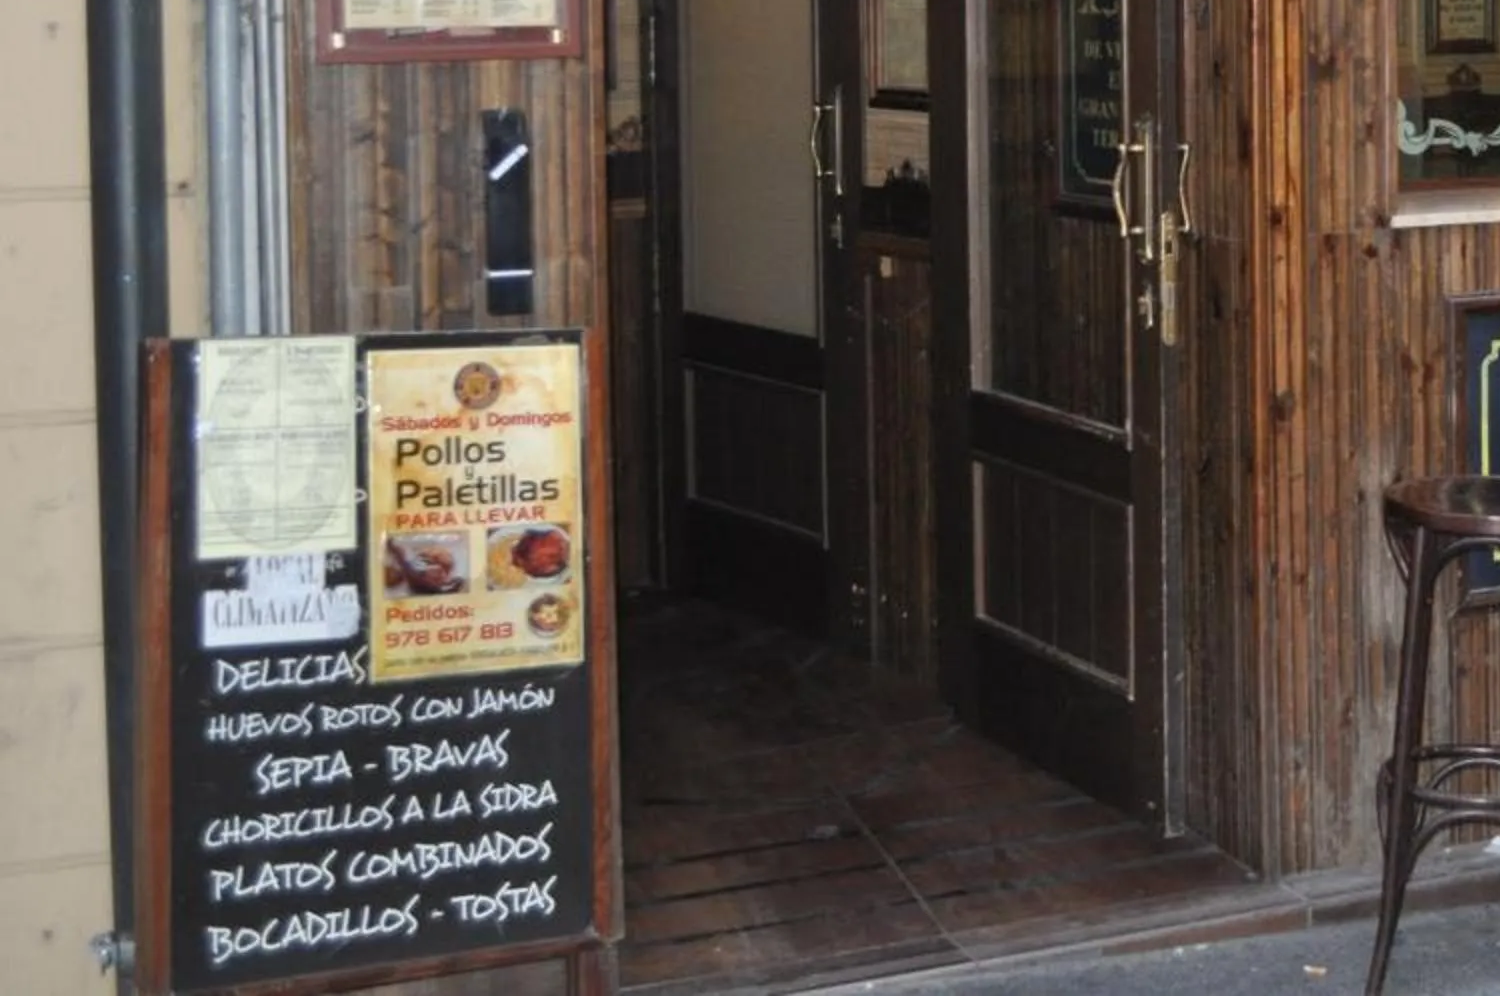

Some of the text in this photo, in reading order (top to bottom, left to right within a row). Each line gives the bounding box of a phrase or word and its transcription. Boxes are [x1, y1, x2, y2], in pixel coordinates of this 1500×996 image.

[486, 410, 573, 428] Domingos
[396, 435, 506, 469] Pollos
[396, 474, 560, 511] Paletillas
[395, 505, 546, 529] PARA LLEVAR
[385, 621, 514, 649] 978 617 813
[386, 604, 475, 623] Pedidos:
[215, 646, 370, 695] DELICIAS
[207, 683, 556, 741] HUEVOS ROTOS CON JAMÓN
[255, 749, 352, 795] SEPIA
[387, 729, 511, 780] BRAVAS
[203, 780, 558, 849] CHORICILLOS A LA SIDRA
[211, 822, 554, 902] PLATOS COMBINADOS
[207, 894, 420, 964] BOCADILLOS
[451, 875, 558, 923] TOSTAS
